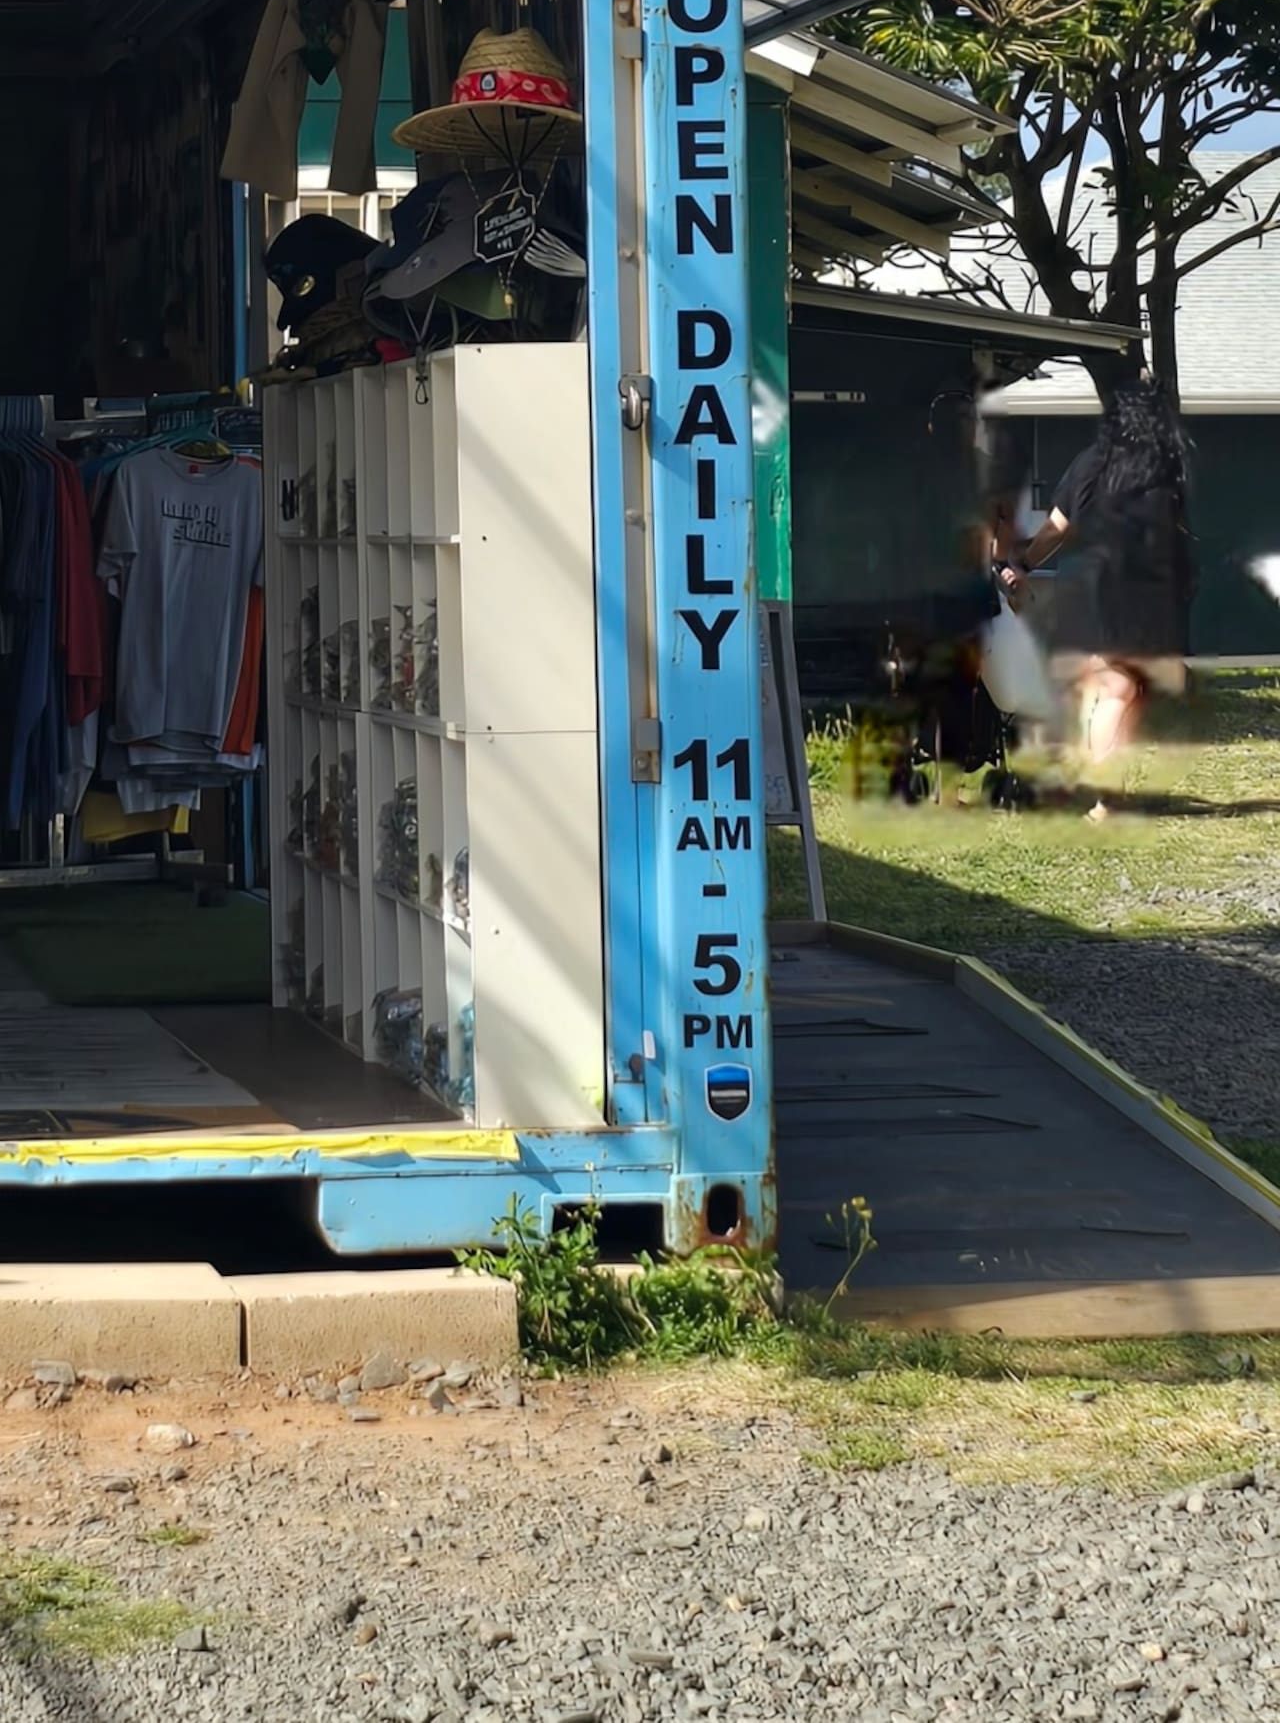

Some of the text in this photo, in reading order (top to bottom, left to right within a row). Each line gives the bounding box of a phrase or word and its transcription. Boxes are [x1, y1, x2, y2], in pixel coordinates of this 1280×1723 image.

[674, 309, 738, 671] DAILY
[673, 738, 752, 802] 11
[676, 815, 752, 852] AM
[692, 933, 742, 997] 5
[682, 1013, 753, 1050] PM
